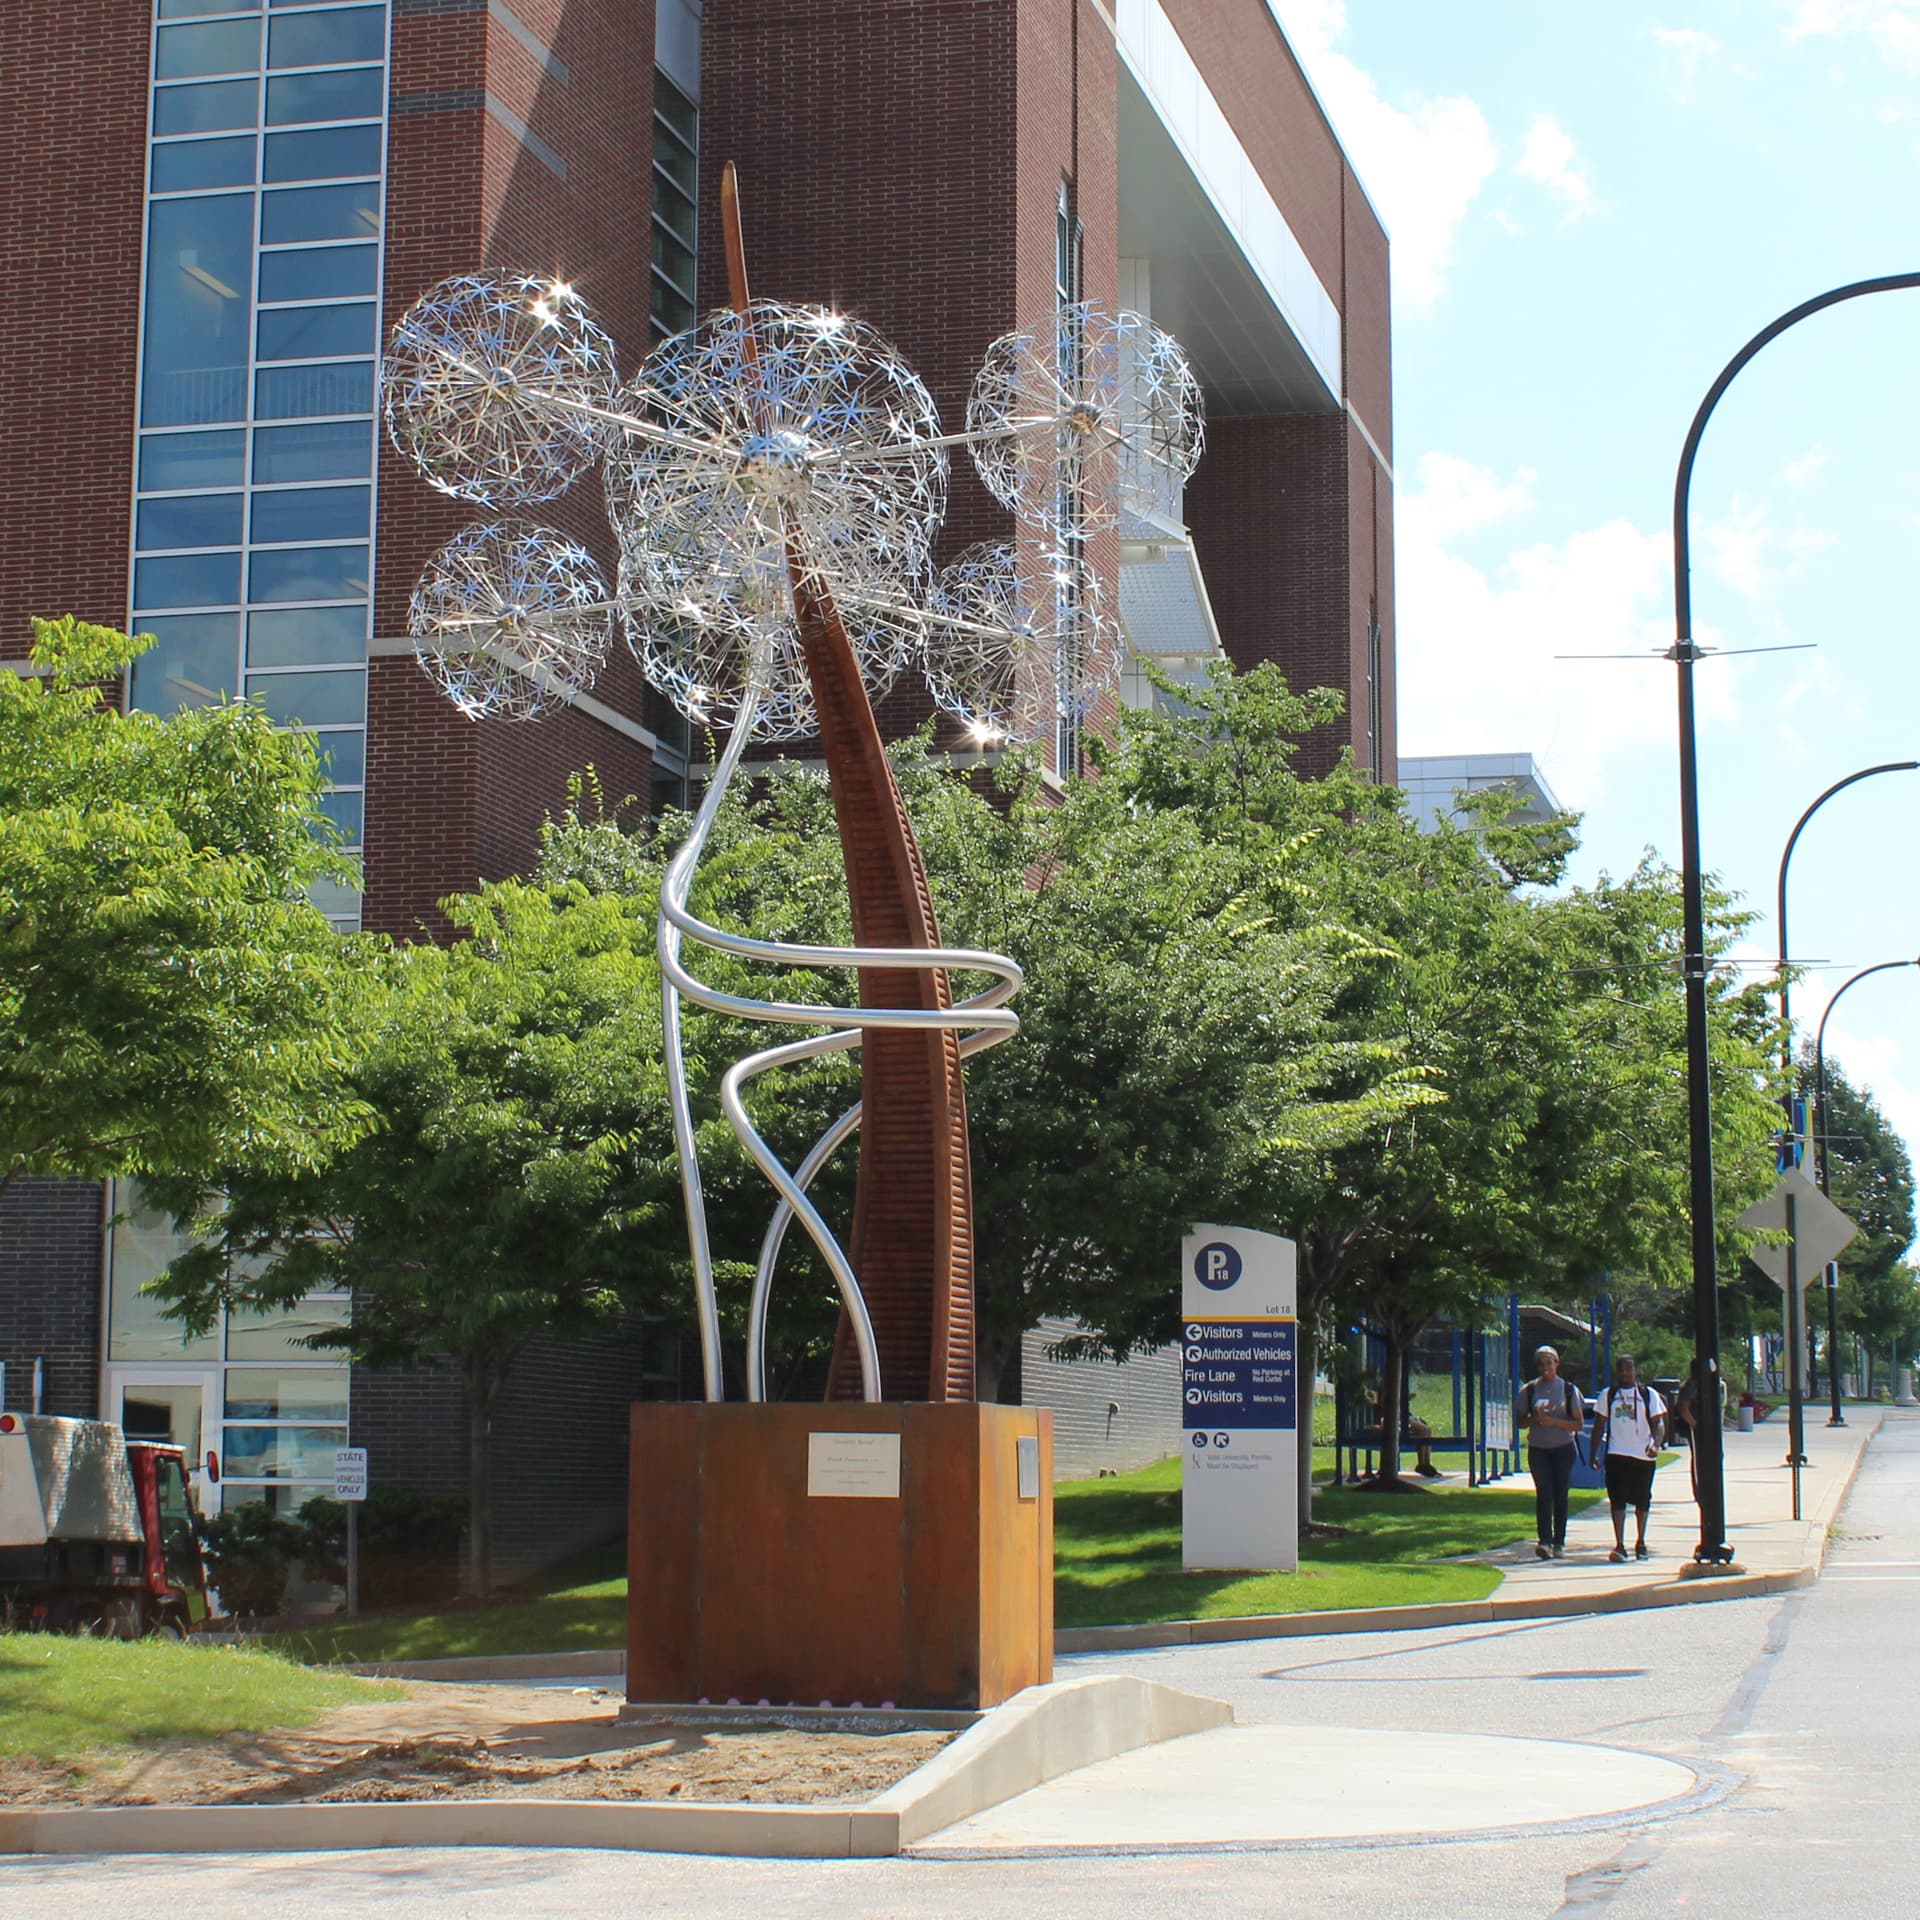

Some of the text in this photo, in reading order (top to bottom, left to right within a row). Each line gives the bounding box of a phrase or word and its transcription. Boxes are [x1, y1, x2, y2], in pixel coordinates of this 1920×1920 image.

[1265, 1305, 1291, 1314] Lot 18
[1202, 1326, 1243, 1339] Visitors
[1273, 1331, 1286, 1340] Only
[1202, 1346, 1292, 1360] Authorized Vehicles
[1184, 1369, 1236, 1382] Fire Lane
[1202, 1390, 1243, 1403] Visitors
[1273, 1395, 1286, 1403] Only
[337, 1453, 365, 1462] STATE
[338, 1485, 361, 1494] ONLY
